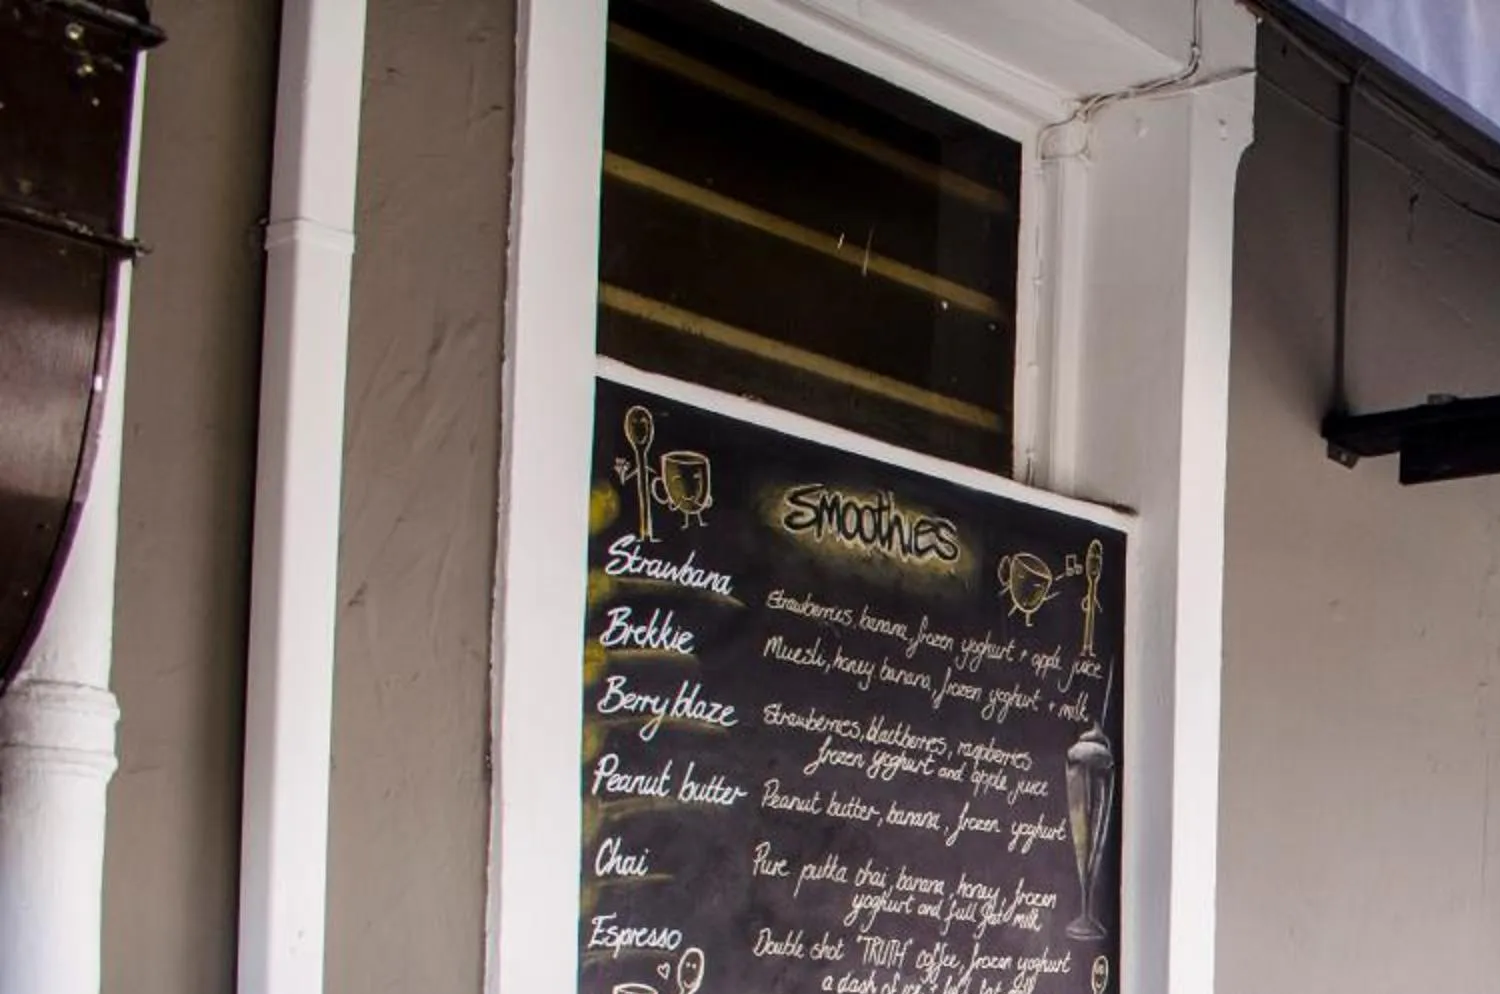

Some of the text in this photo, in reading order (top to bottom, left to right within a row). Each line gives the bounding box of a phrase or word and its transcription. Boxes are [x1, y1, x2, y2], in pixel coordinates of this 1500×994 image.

[605, 534, 733, 596] Strawbana
[600, 606, 695, 653] Brekkie
[597, 675, 739, 742] Berry blaze
[591, 753, 748, 806] Peanut butter
[804, 736, 865, 776] frozen
[866, 744, 936, 781] yoghurt
[937, 762, 964, 783] and
[761, 778, 822, 815] Peanut
[945, 802, 1001, 847] frozen
[1007, 813, 1068, 854] yoghurt
[594, 835, 649, 877] Chai
[752, 841, 791, 877] Pure
[1003, 877, 1057, 922] frozen
[588, 912, 683, 959] Espresso
[843, 890, 917, 933] yoghurt
[753, 927, 805, 959] Double
[809, 931, 845, 961] shot
[1013, 947, 1072, 989] yoghurt
[837, 970, 879, 994] dash
